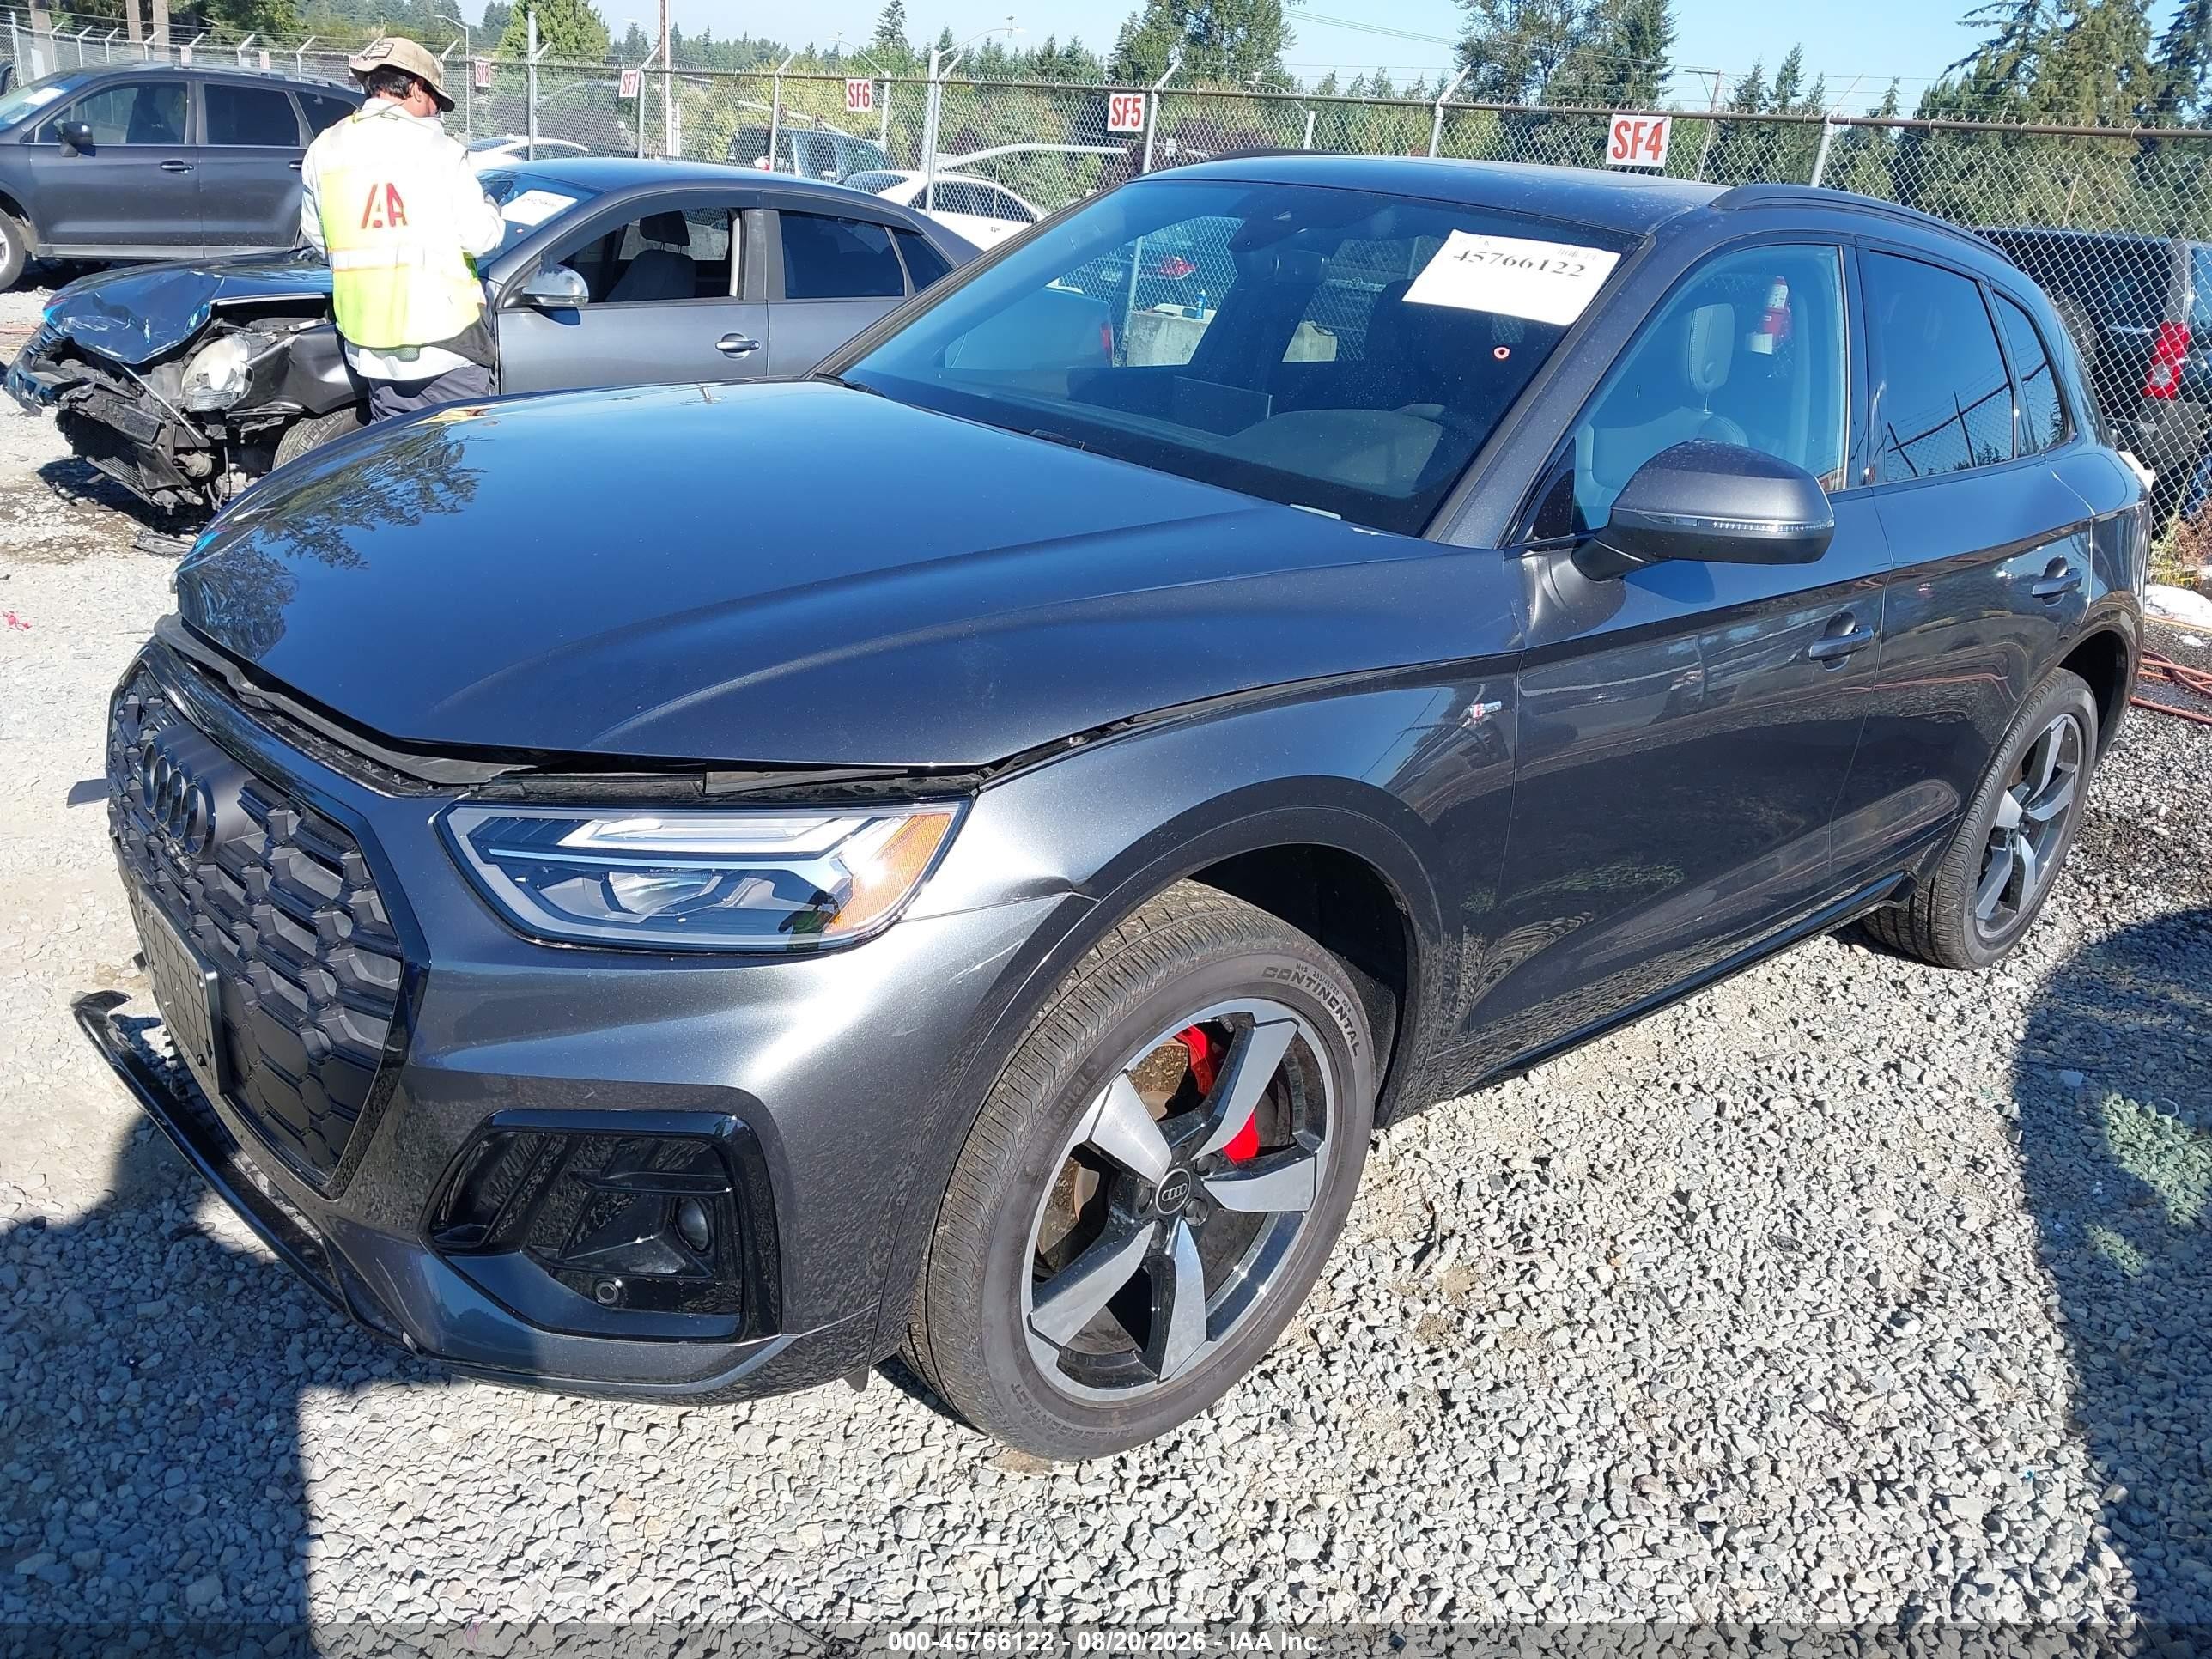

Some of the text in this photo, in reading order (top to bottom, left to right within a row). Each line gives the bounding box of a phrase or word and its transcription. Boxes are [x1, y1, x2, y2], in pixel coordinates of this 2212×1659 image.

[477, 62, 490, 84] SF8
[622, 71, 638, 94] SF7
[848, 82, 870, 108] SF6
[1111, 96, 1142, 127] SF5
[1612, 120, 1664, 161] SF4
[1453, 249, 1587, 278] 45766122
[1261, 966, 1360, 1057] CONTINENTAL
